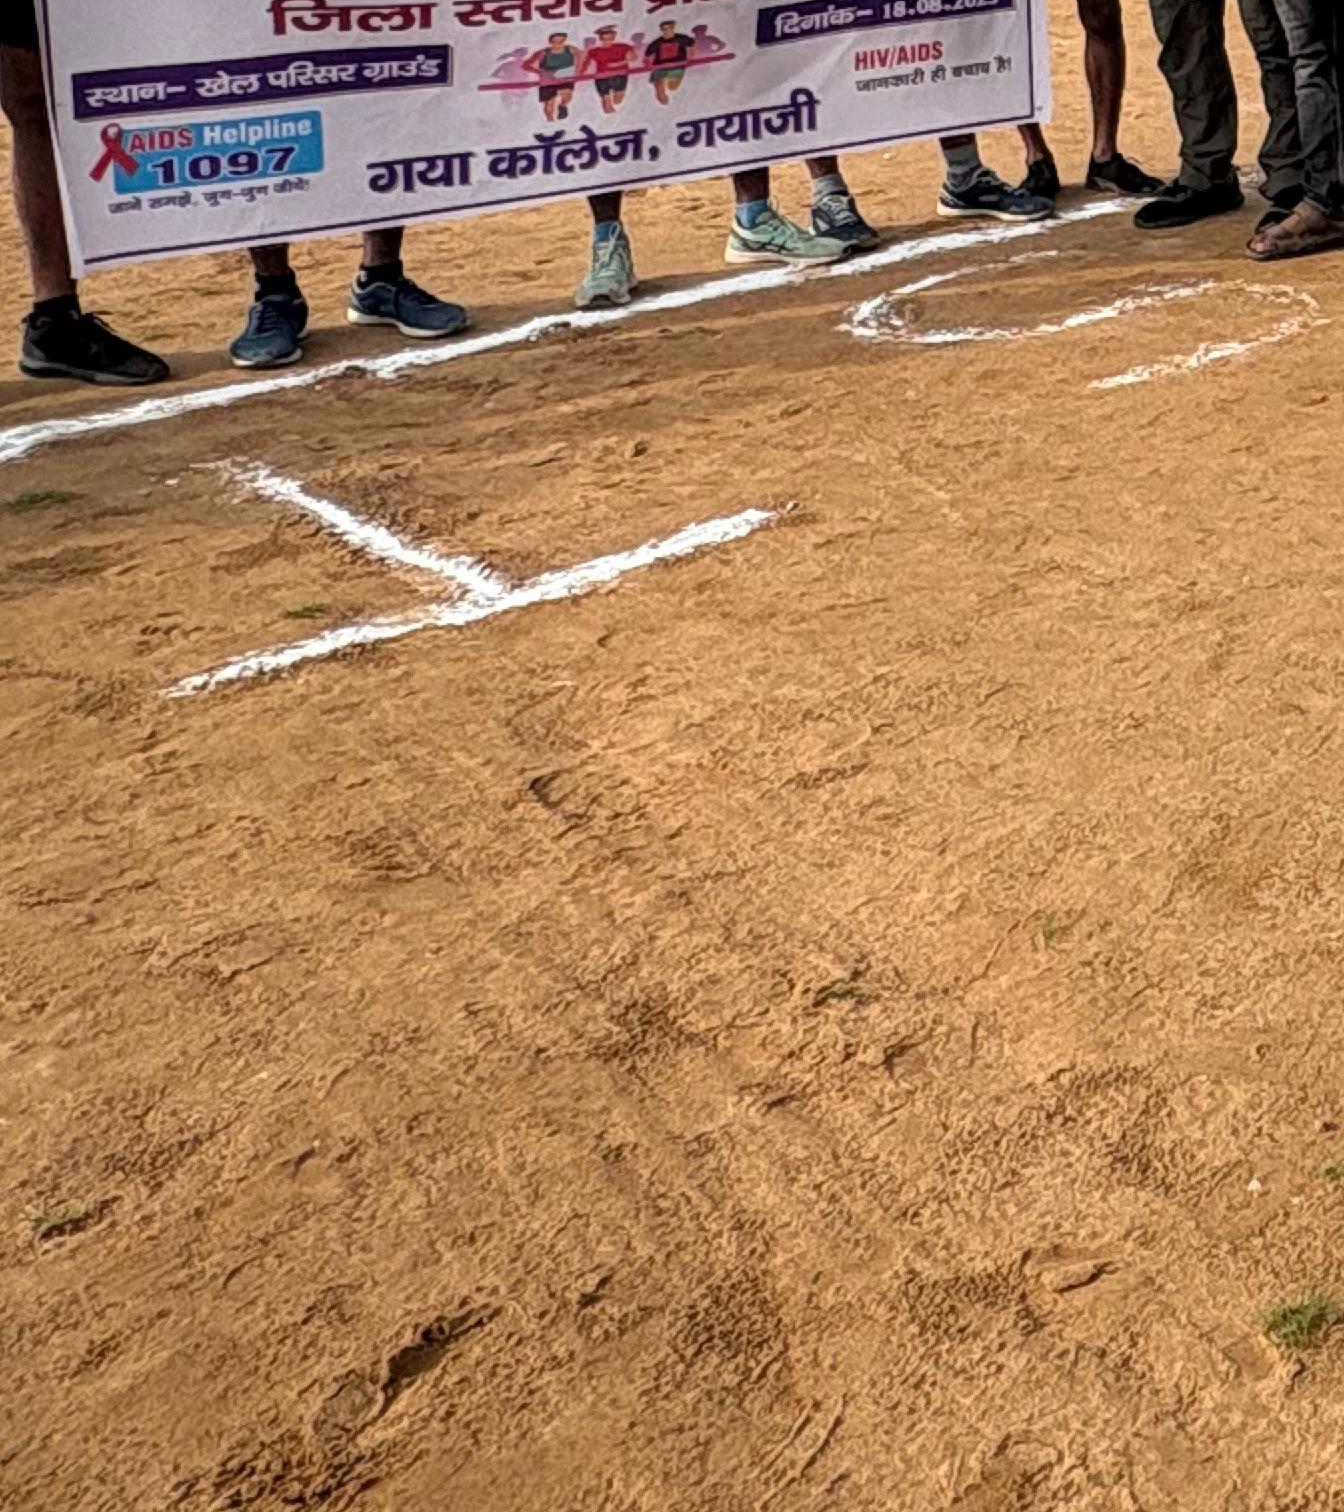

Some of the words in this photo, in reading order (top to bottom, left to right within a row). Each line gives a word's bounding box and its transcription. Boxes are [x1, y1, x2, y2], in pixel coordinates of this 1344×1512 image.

[854, 41, 944, 71] HIV/AIDS
[194, 70, 263, 98] खेल
[266, 60, 358, 89] परिसर
[362, 54, 443, 83] ग्राउंड
[855, 67, 925, 92] जानकारी
[931, 65, 947, 83] ही
[129, 127, 193, 153] AIDS
[202, 118, 312, 147] Helpline
[366, 151, 475, 194] गया
[487, 125, 660, 180] कॉलेज,
[677, 88, 820, 149] गयाजी
[150, 145, 297, 185] 1097
